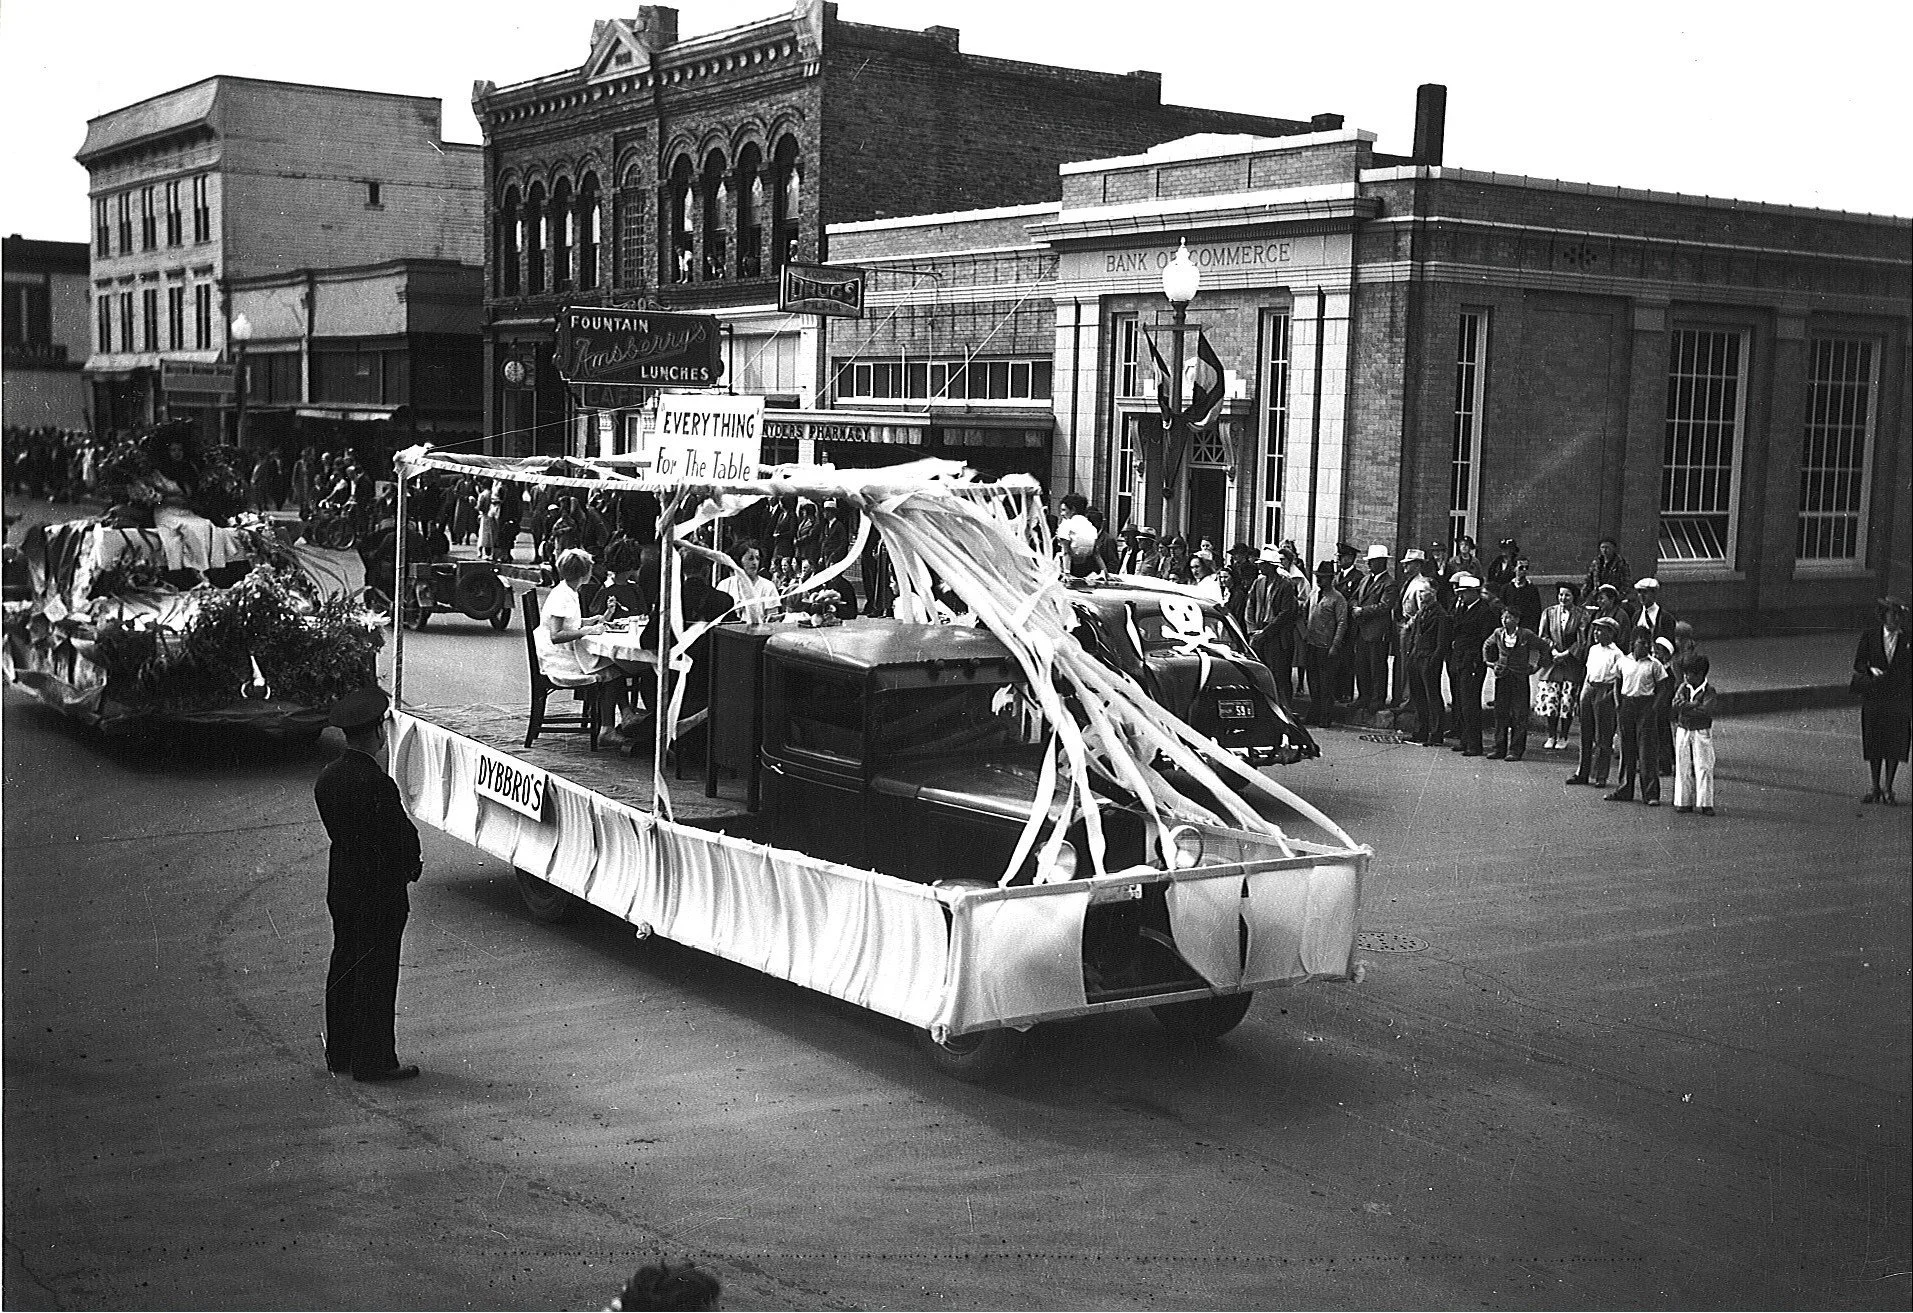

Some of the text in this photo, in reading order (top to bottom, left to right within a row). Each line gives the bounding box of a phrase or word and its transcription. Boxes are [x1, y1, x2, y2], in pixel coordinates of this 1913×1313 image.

[1106, 252, 1148, 273] BANK
[1188, 243, 1290, 267] COMMERCE
[791, 275, 857, 304] DRUGS
[571, 315, 649, 333] FOUNTAIN
[641, 366, 709, 381] LUNCHES
[809, 424, 869, 441] PHARMACY
[656, 446, 751, 481] For The Table
[478, 754, 542, 811] DYBBRO'S
